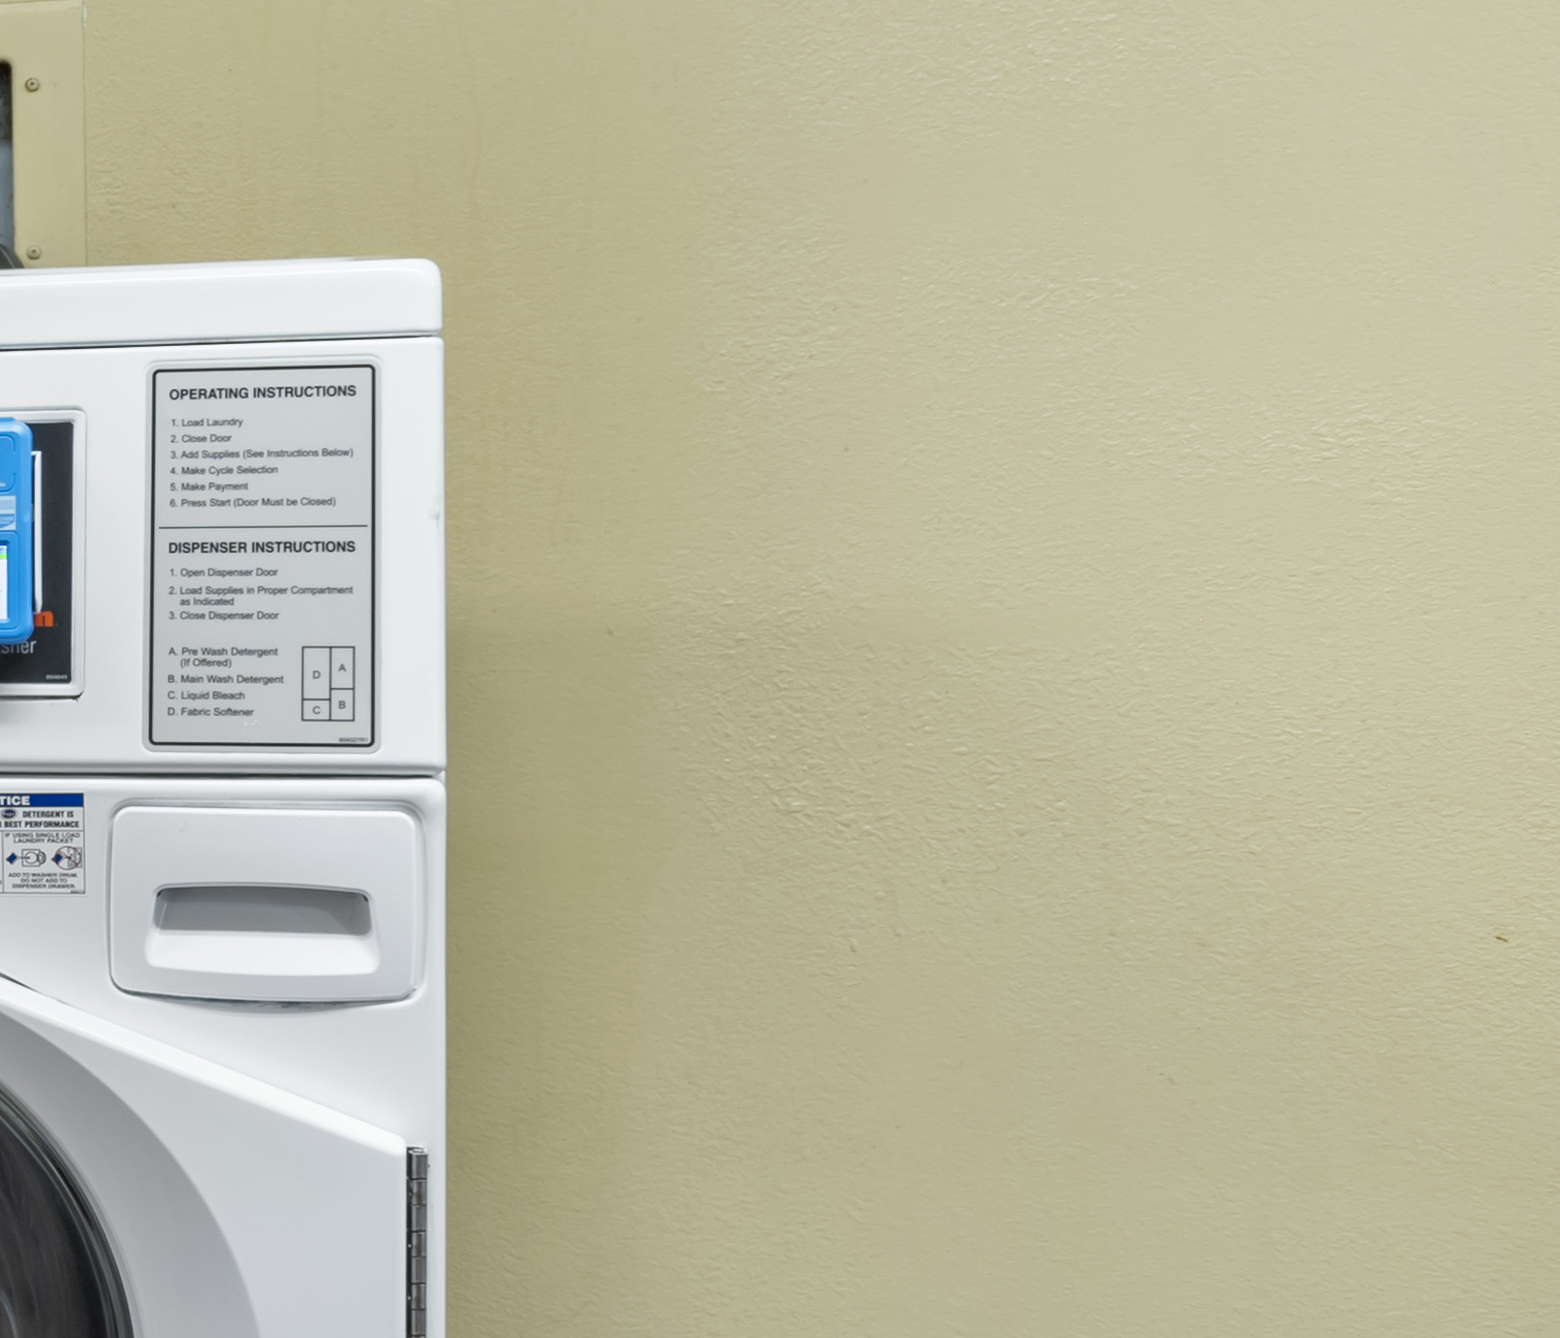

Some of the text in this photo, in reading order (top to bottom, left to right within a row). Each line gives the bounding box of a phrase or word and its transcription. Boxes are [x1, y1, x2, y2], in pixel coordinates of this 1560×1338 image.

[169, 385, 357, 401] OPERATING INSTRUCTIONS
[181, 418, 204, 427] Load
[206, 418, 243, 428] Laundry
[181, 434, 207, 443] Close
[210, 434, 232, 443] Door
[181, 450, 199, 459] Add
[201, 450, 240, 460] Supplies
[243, 449, 264, 460] (See
[267, 449, 319, 458] Instructions
[321, 448, 354, 459] Below)
[181, 466, 206, 475] Make
[208, 466, 234, 476] Cycle
[236, 466, 278, 475] Selection
[181, 482, 206, 491] Make
[208, 482, 249, 493] Payment
[181, 498, 207, 508] Press
[209, 498, 231, 507] Start
[233, 498, 259, 508] (Door
[261, 497, 284, 507] Must
[286, 497, 298, 507] be
[300, 497, 336, 507] Closed)
[168, 541, 356, 554] DISPENSER INSTRUCTIONS
[180, 568, 205, 578] Open
[208, 568, 254, 578] Dispenser
[256, 568, 278, 577] Door
[180, 586, 203, 595] Load
[205, 586, 244, 596] Supplies
[246, 586, 255, 595] in
[257, 586, 288, 596] Proper
[290, 586, 354, 596] Compartment
[193, 597, 234, 606] Indicated
[180, 611, 206, 620] Close
[208, 611, 254, 621] Dispenser
[257, 611, 279, 620] Door
[338, 663, 347, 672] A
[312, 670, 321, 679] D
[338, 700, 346, 709] B
[312, 705, 321, 715] C
